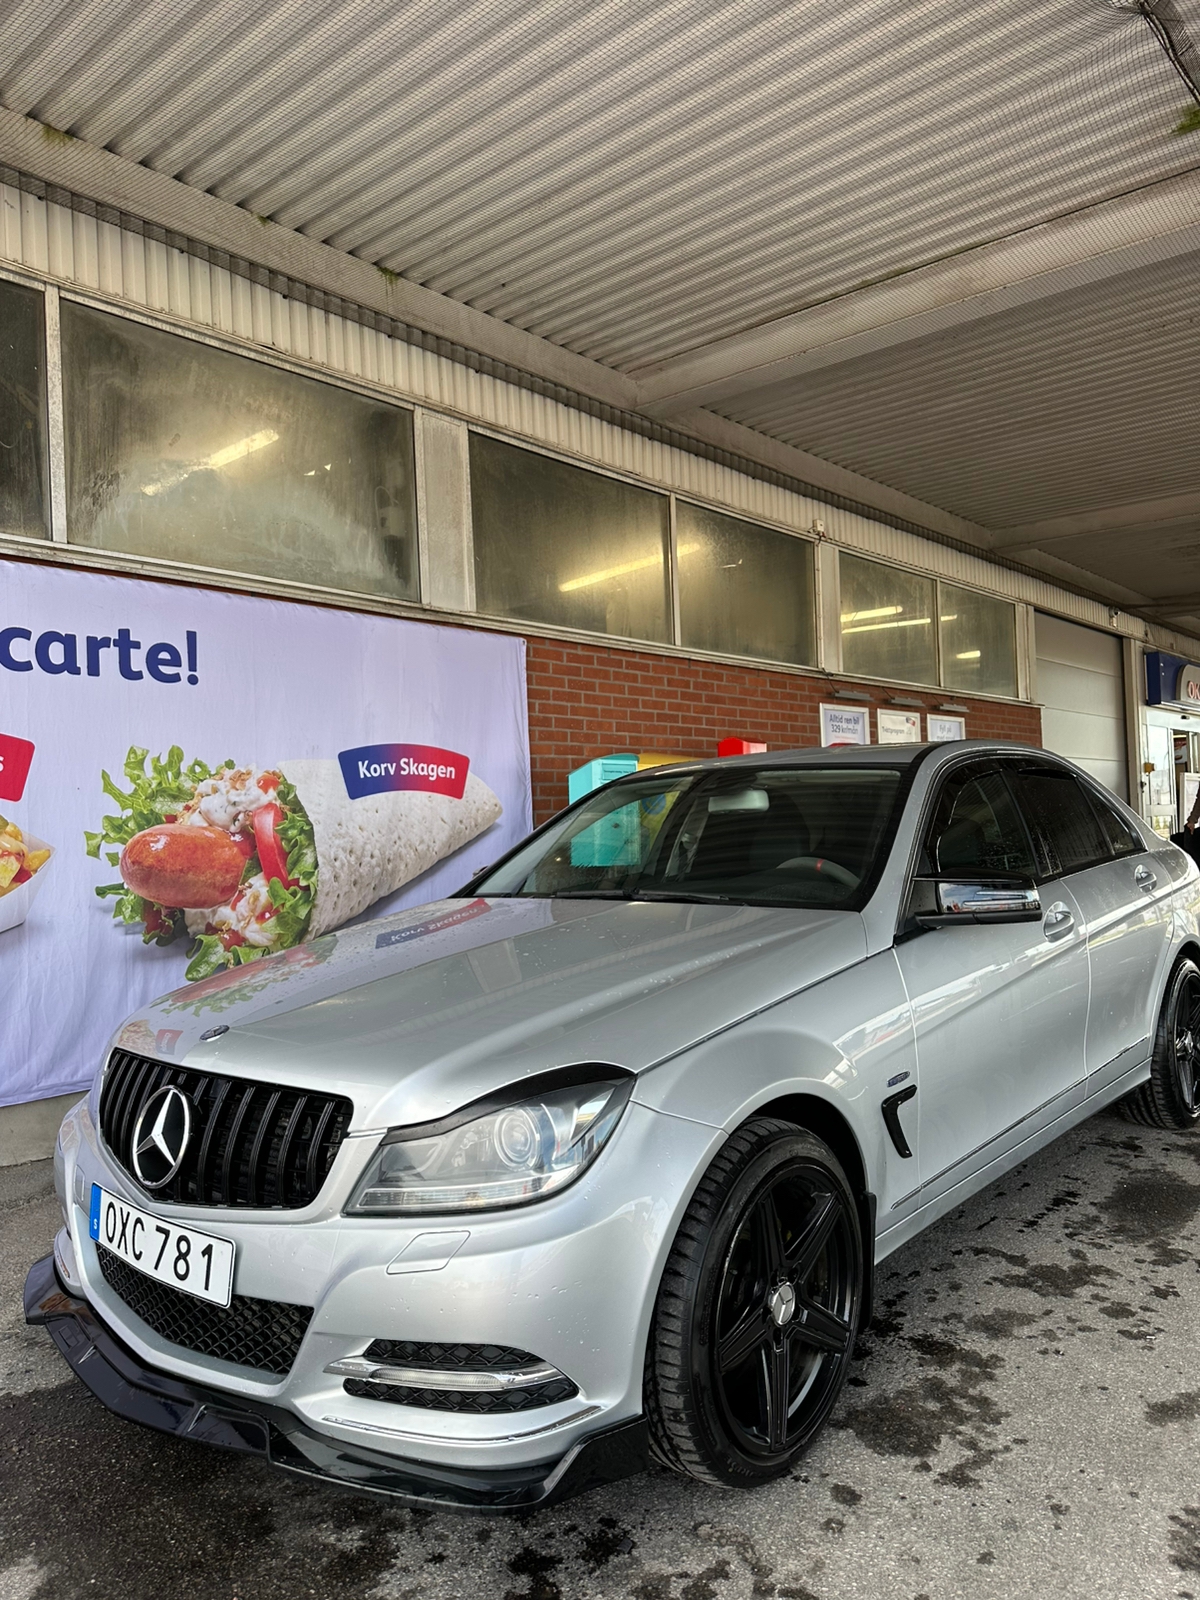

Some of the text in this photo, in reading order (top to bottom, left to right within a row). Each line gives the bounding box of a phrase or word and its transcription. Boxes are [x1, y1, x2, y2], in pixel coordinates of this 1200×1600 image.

[0, 626, 199, 686] carte!
[829, 713, 843, 724] Alltid
[844, 717, 852, 725] ren
[831, 724, 841, 733] 329
[358, 758, 456, 781] Korv Skagen
[106, 1201, 214, 1292] OXC 781
